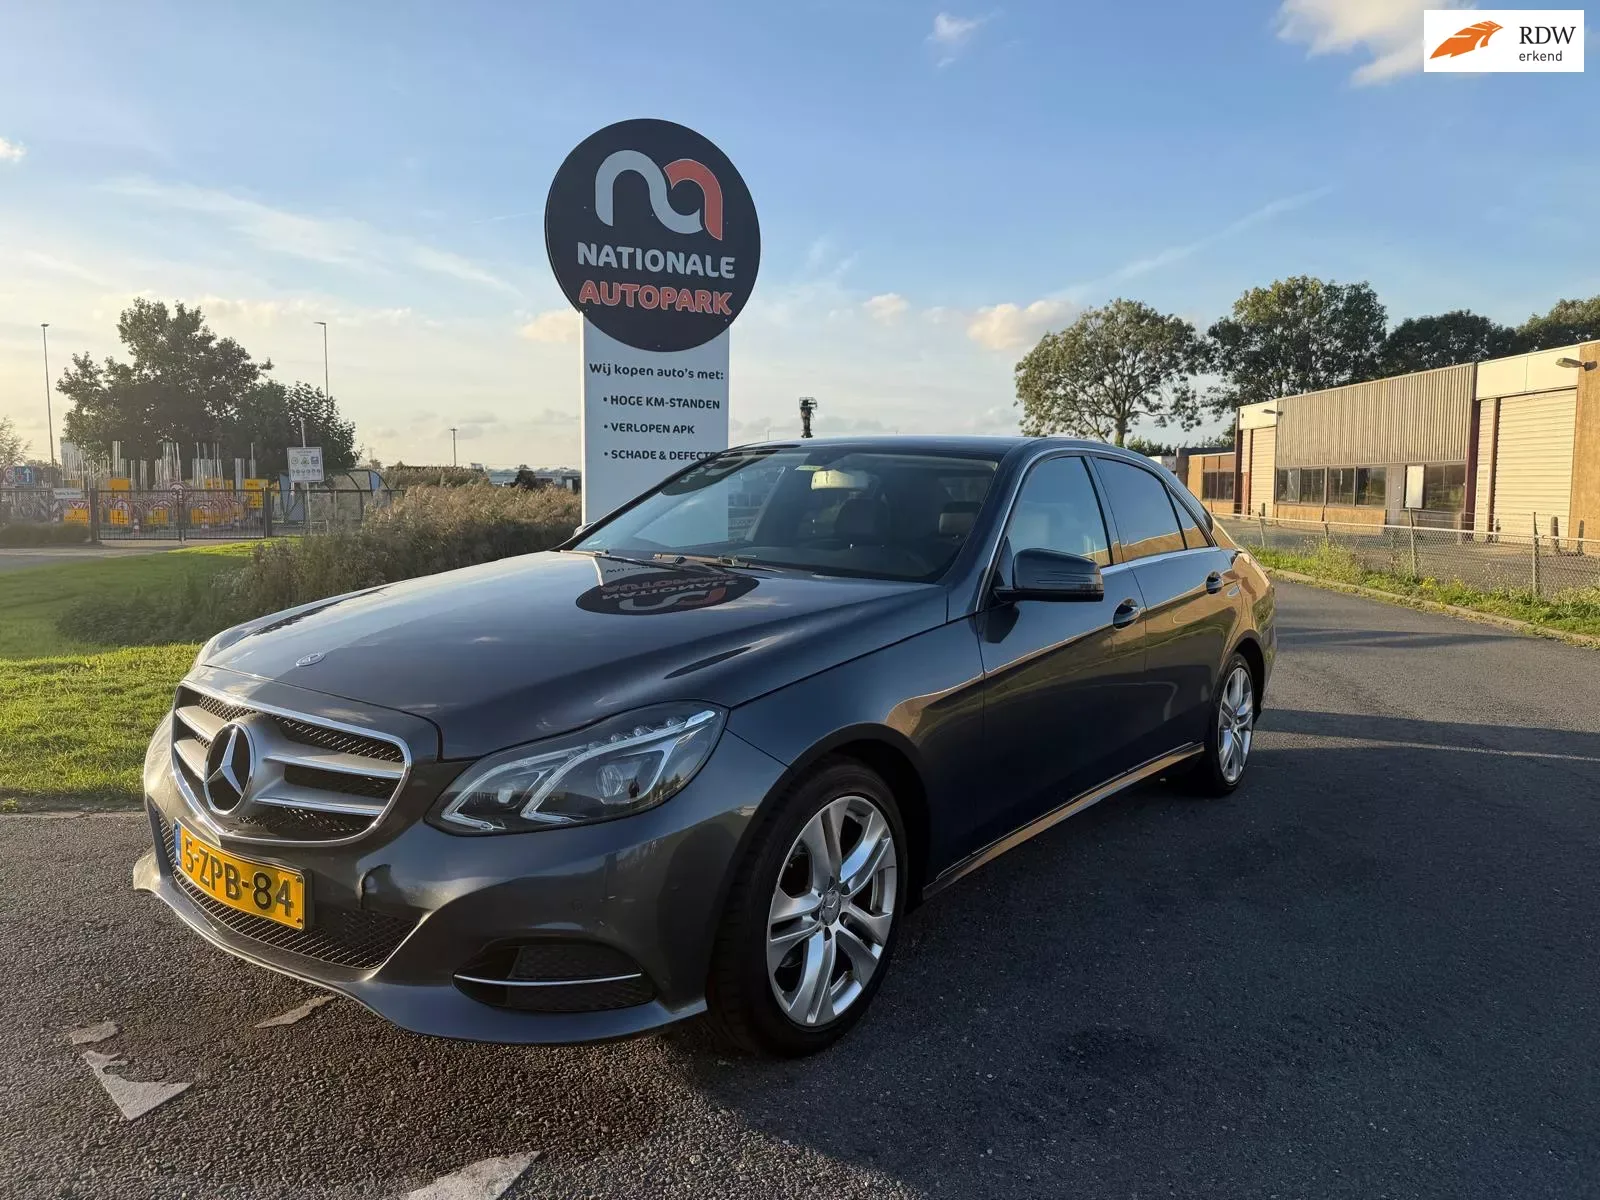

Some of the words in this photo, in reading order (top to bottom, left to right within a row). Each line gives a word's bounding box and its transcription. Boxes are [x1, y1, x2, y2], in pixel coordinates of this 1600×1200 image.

[577, 241, 736, 279] NATIONALE
[579, 279, 733, 315] AUTOPARK
[589, 363, 611, 376] Wij
[614, 364, 654, 377] kopen
[657, 368, 694, 379] auto's
[697, 370, 724, 380] met:
[610, 395, 643, 406] HOGE
[646, 397, 720, 409] KM-STANDEN
[611, 423, 670, 433] VERLOPEN
[673, 424, 695, 434] APK
[611, 450, 656, 460] SCHADE
[659, 451, 667, 460] &
[185, 836, 294, 917] 5-ZPB-84
